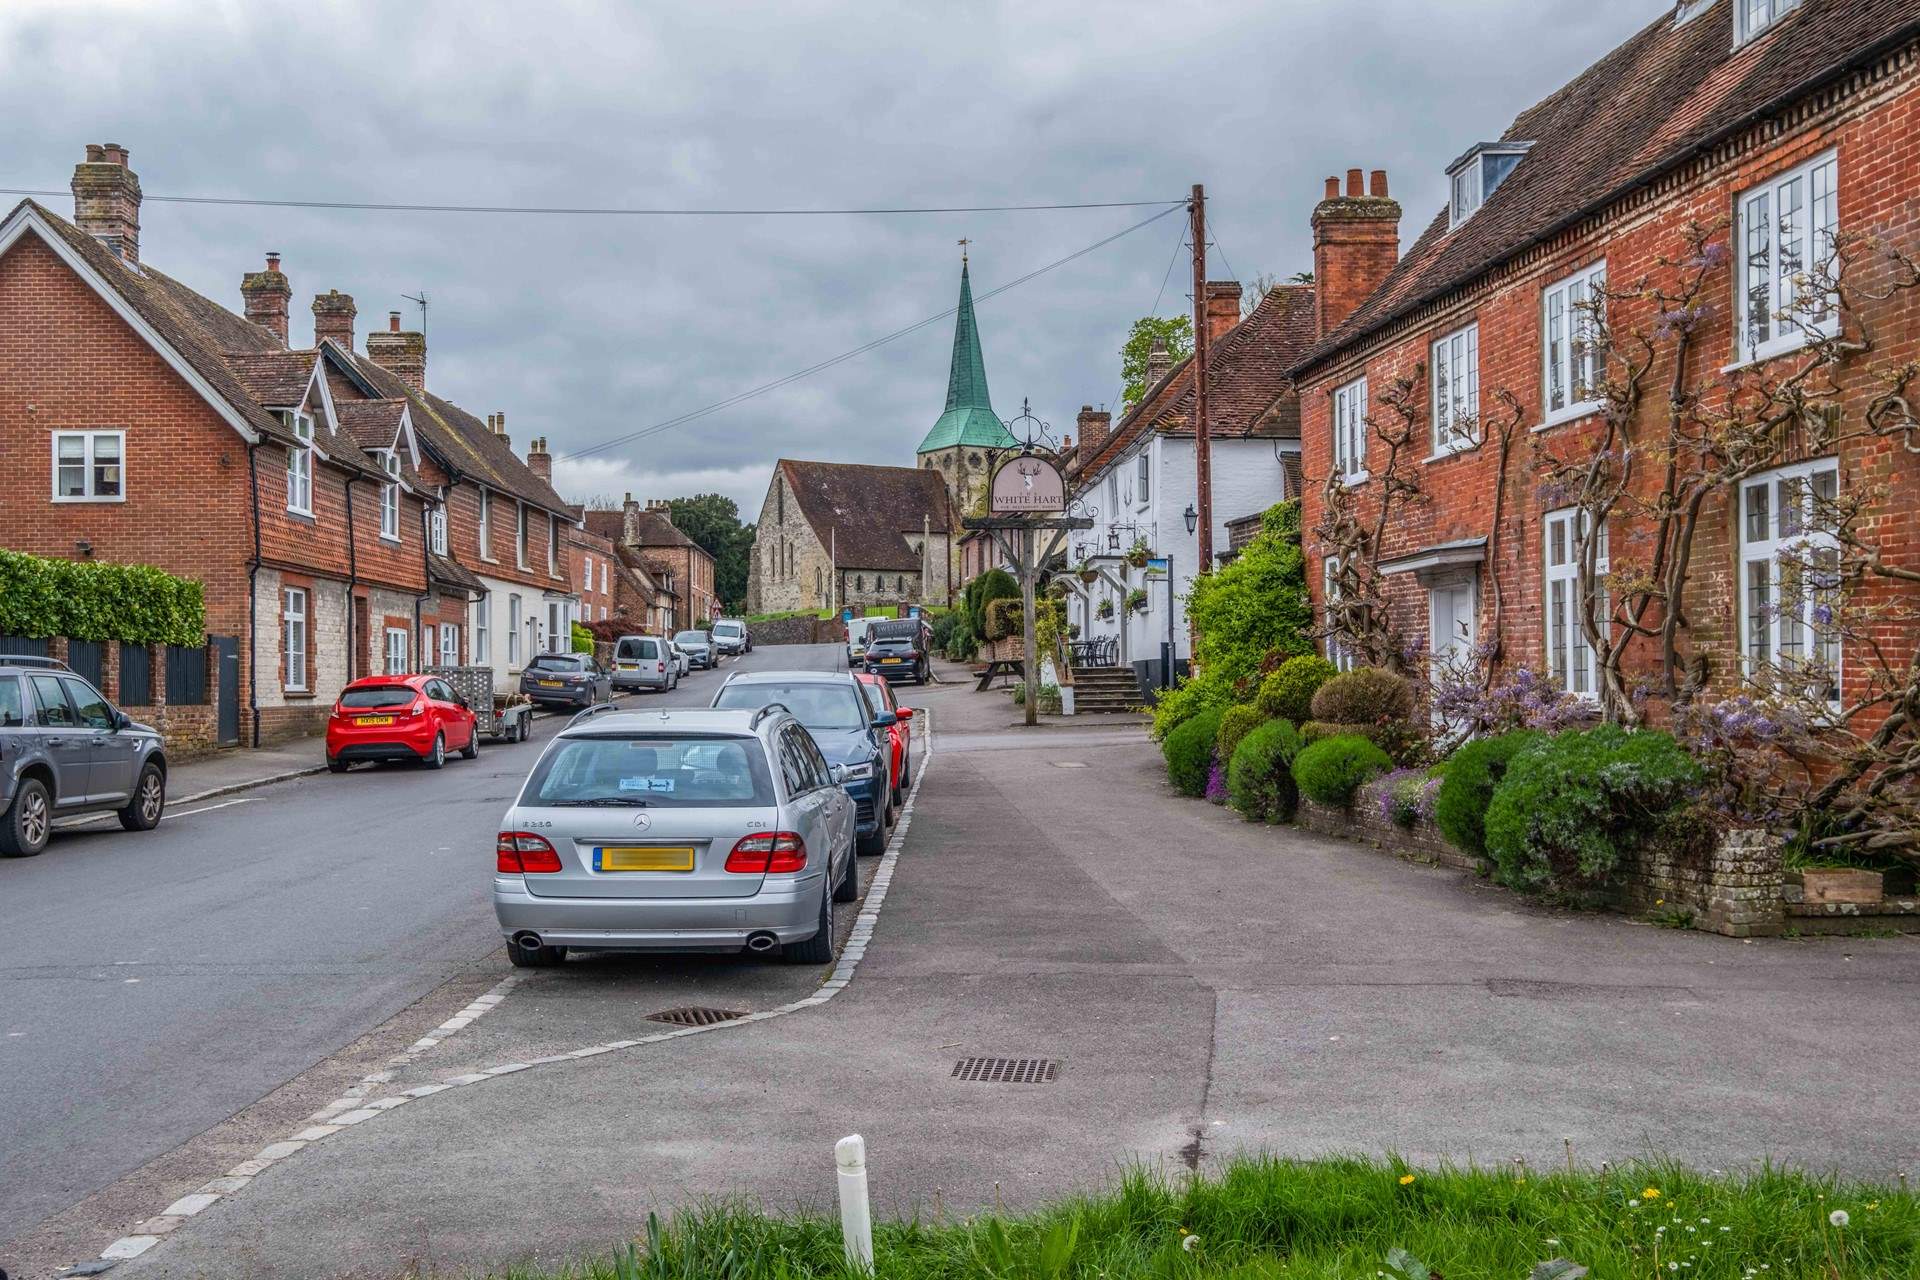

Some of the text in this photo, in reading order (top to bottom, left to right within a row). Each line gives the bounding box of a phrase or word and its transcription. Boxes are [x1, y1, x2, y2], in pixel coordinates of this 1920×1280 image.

[994, 496, 1064, 504] WHITE HART
[876, 623, 917, 632] SWEETAPPLE
